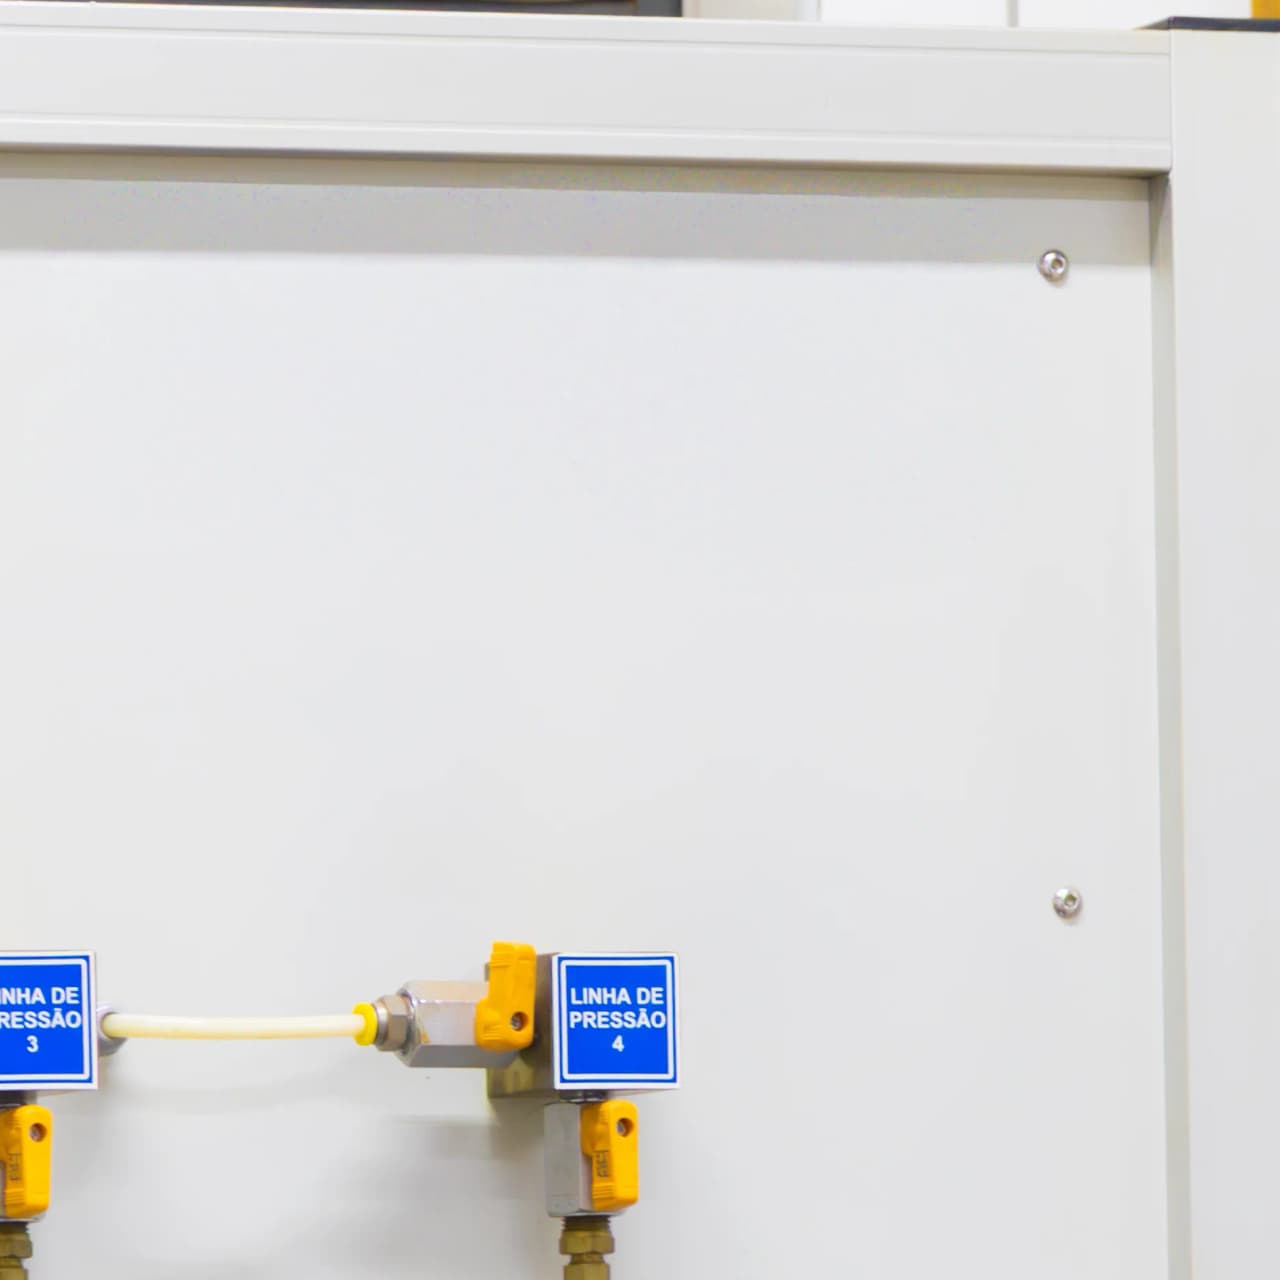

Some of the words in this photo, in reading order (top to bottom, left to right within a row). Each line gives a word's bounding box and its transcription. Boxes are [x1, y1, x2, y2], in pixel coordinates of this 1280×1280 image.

[51, 986, 79, 1005] DE
[570, 987, 632, 1005] LINHA
[636, 986, 664, 1005] DE
[569, 1008, 667, 1029] PRESSÃO
[26, 1035, 39, 1053] 3
[611, 1035, 625, 1052] 4
